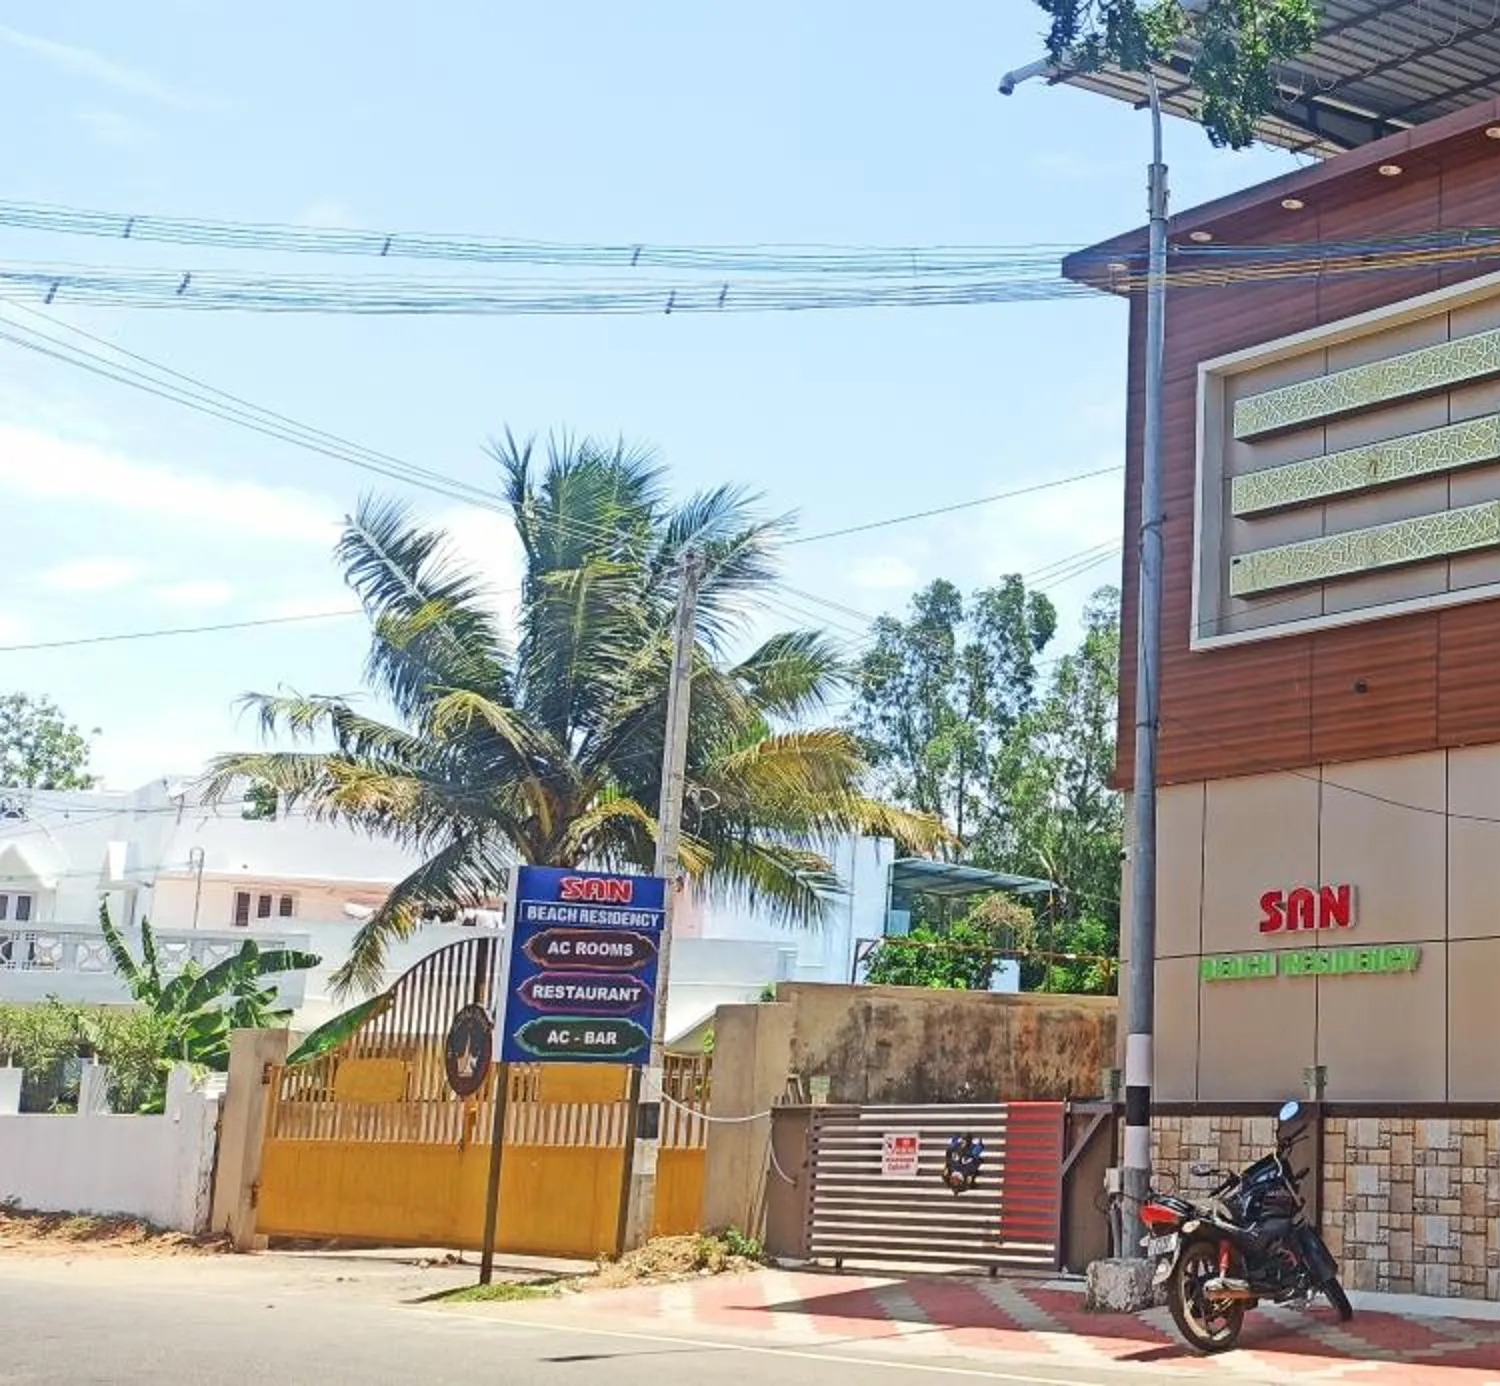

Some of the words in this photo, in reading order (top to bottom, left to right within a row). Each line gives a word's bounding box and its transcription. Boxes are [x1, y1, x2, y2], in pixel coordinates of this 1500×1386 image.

[560, 877, 633, 903] SAN
[527, 905, 577, 923] BEACH
[579, 911, 660, 927] RESIDENCY
[1258, 884, 1353, 933] SAN
[547, 941, 571, 955] AC
[575, 941, 633, 957] ROOMS
[532, 985, 641, 1001] RESTAURANT
[547, 1030, 570, 1043] AC
[584, 1031, 617, 1045] BAR
